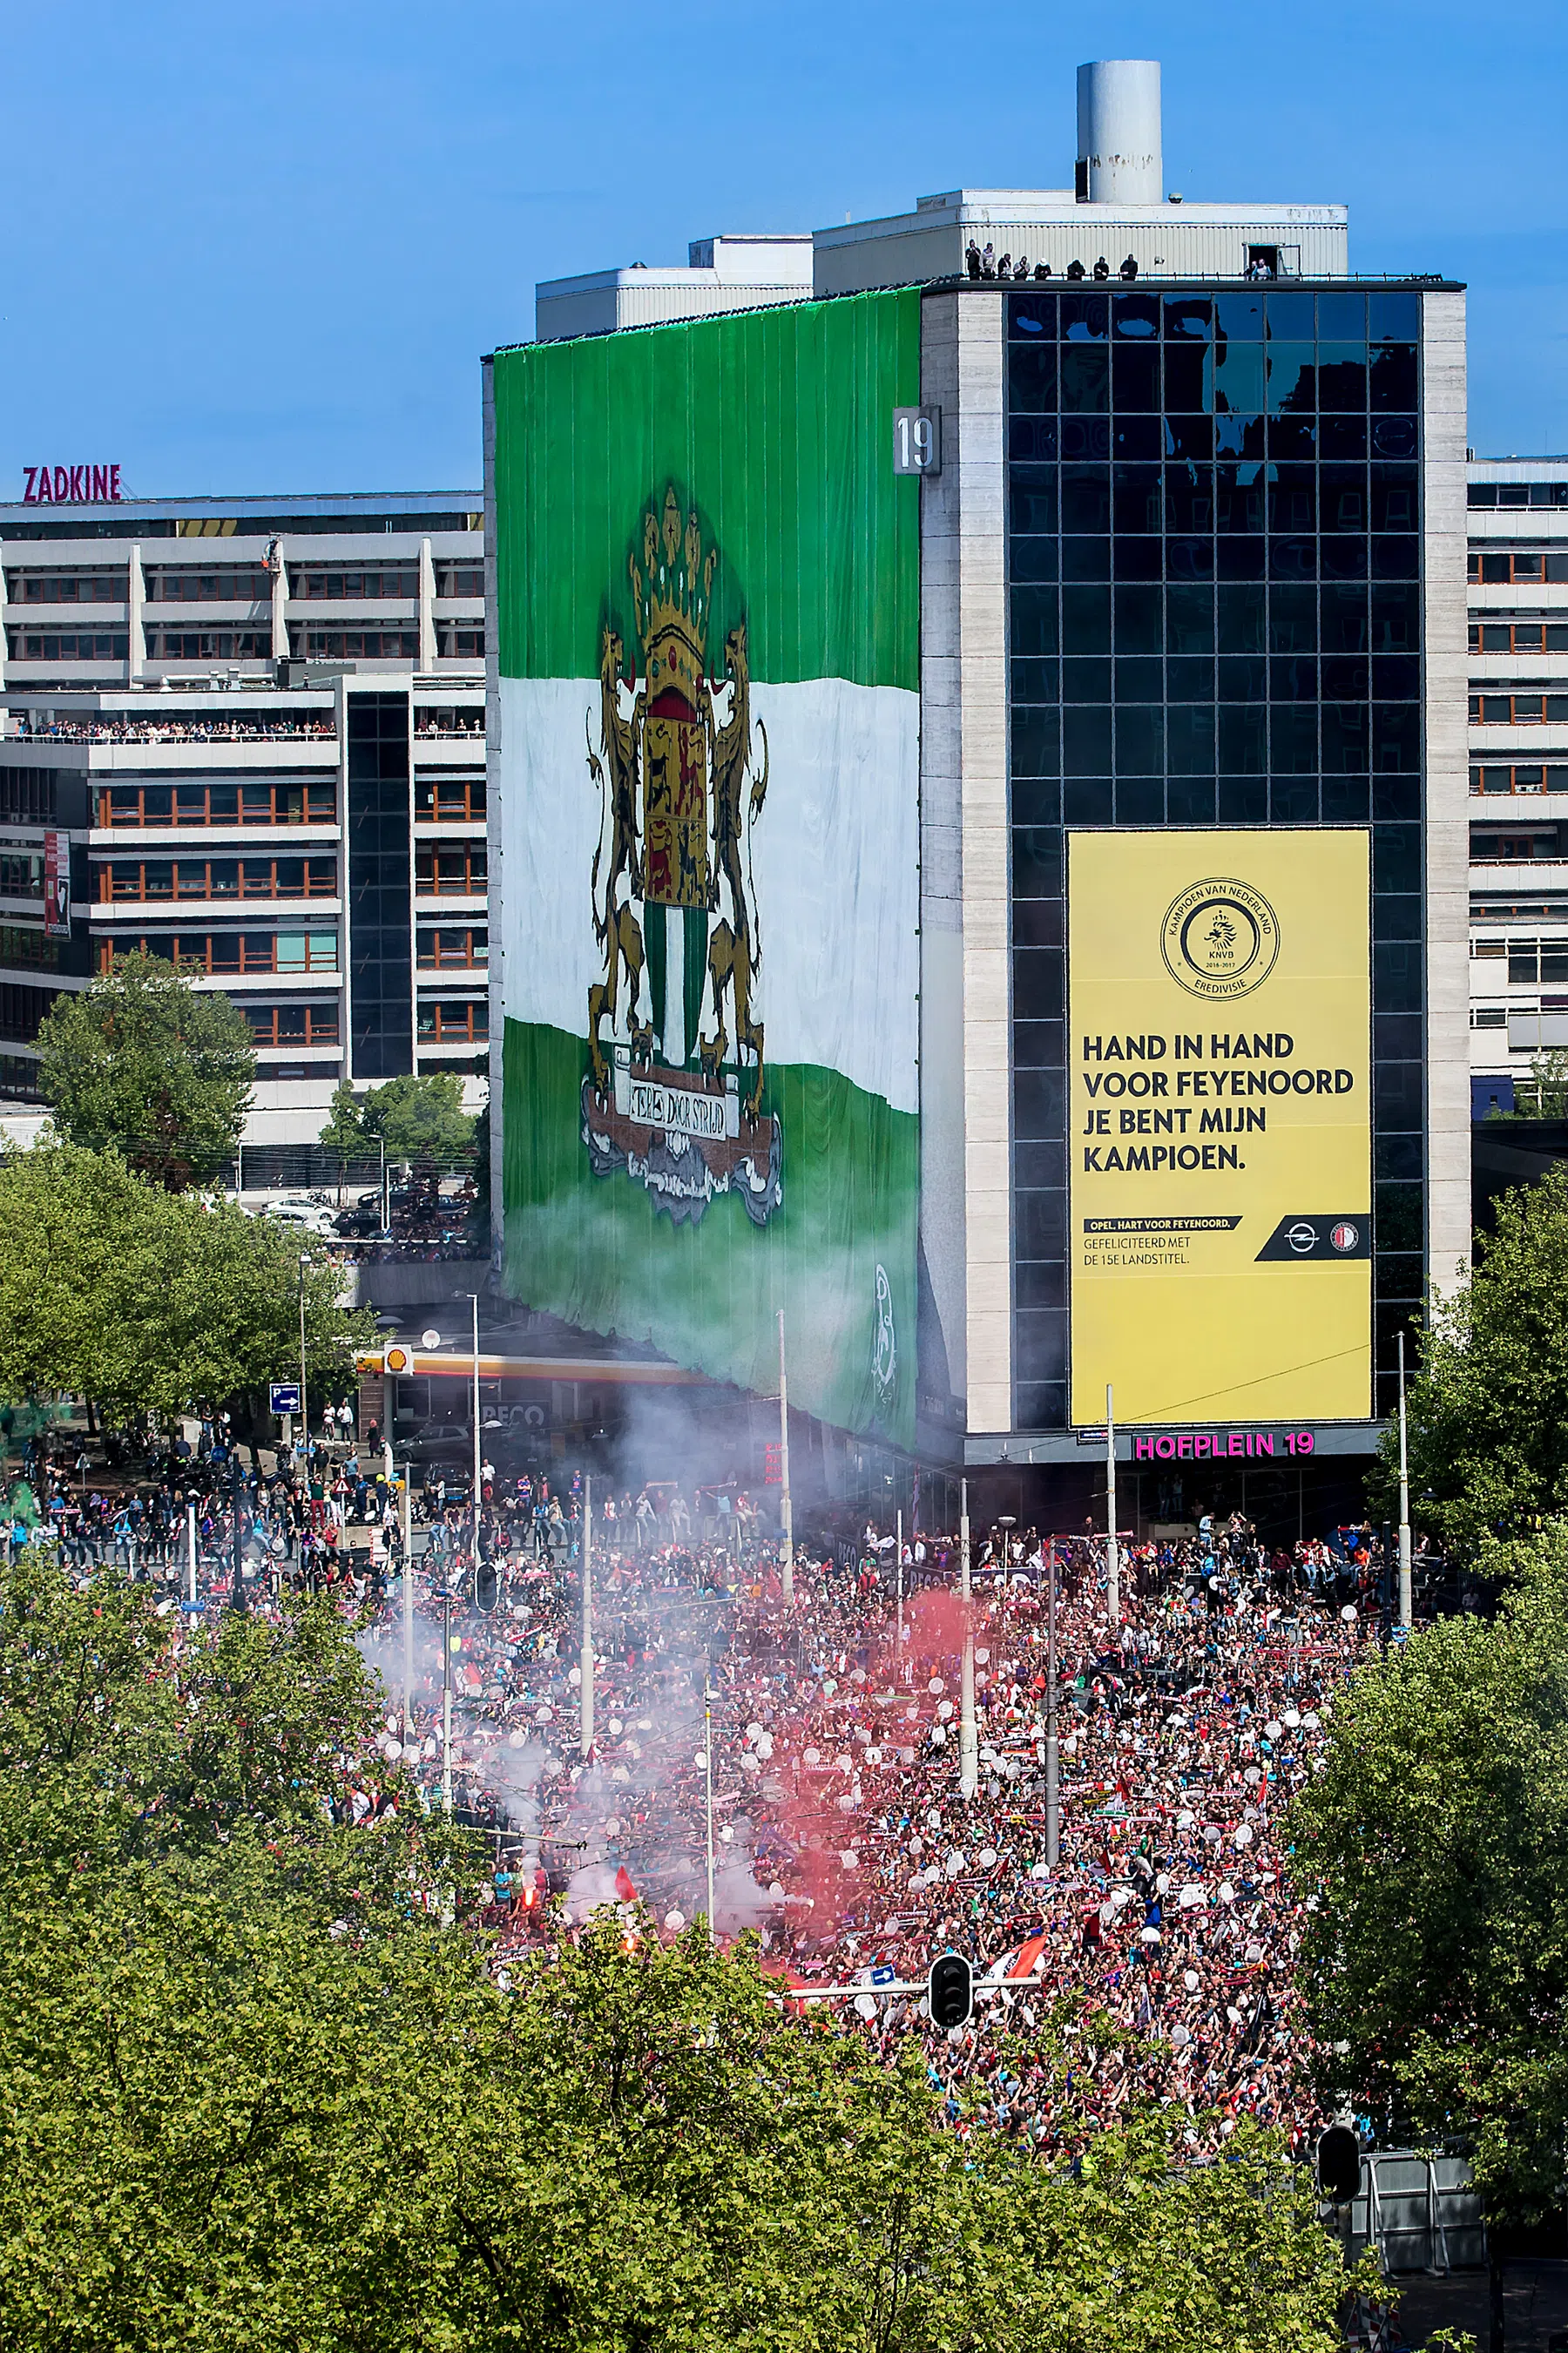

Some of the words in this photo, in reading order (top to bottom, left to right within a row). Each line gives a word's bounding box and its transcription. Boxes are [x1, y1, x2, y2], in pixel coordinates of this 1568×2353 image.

[898, 417, 933, 468] 19
[23, 464, 121, 502] ZADKINE
[1169, 889, 1205, 936] KAMPIOEN
[1205, 885, 1227, 896] VAN
[1228, 886, 1272, 935] NEDERLAND
[1193, 978, 1247, 994] EREDIVISIE
[1083, 1035, 1166, 1061] HAND
[1174, 1034, 1203, 1060] IN
[1211, 1032, 1294, 1059] HAND
[1083, 1072, 1170, 1098] VOOR
[1177, 1069, 1354, 1097] FEYENOORD
[1083, 1110, 1112, 1135] JE
[1119, 1108, 1193, 1134] BENT
[1199, 1106, 1267, 1133] MIJN
[1083, 1144, 1247, 1173] KAMPIOEN.
[1090, 1221, 1116, 1231] OPEL.
[1118, 1220, 1143, 1230] HART
[1143, 1220, 1172, 1229] VOOR
[1173, 1219, 1231, 1229] FEYENOORD.
[1084, 1237, 1166, 1249] GEFELICITEERD
[1168, 1237, 1191, 1248] MET
[1084, 1254, 1098, 1266] DE
[1101, 1254, 1119, 1265] 15E
[1122, 1254, 1190, 1265] LANDSTITEL.
[273, 1388, 281, 1397] P
[1136, 1433, 1274, 1459] HOFPLEIN
[1285, 1431, 1315, 1454] 19
